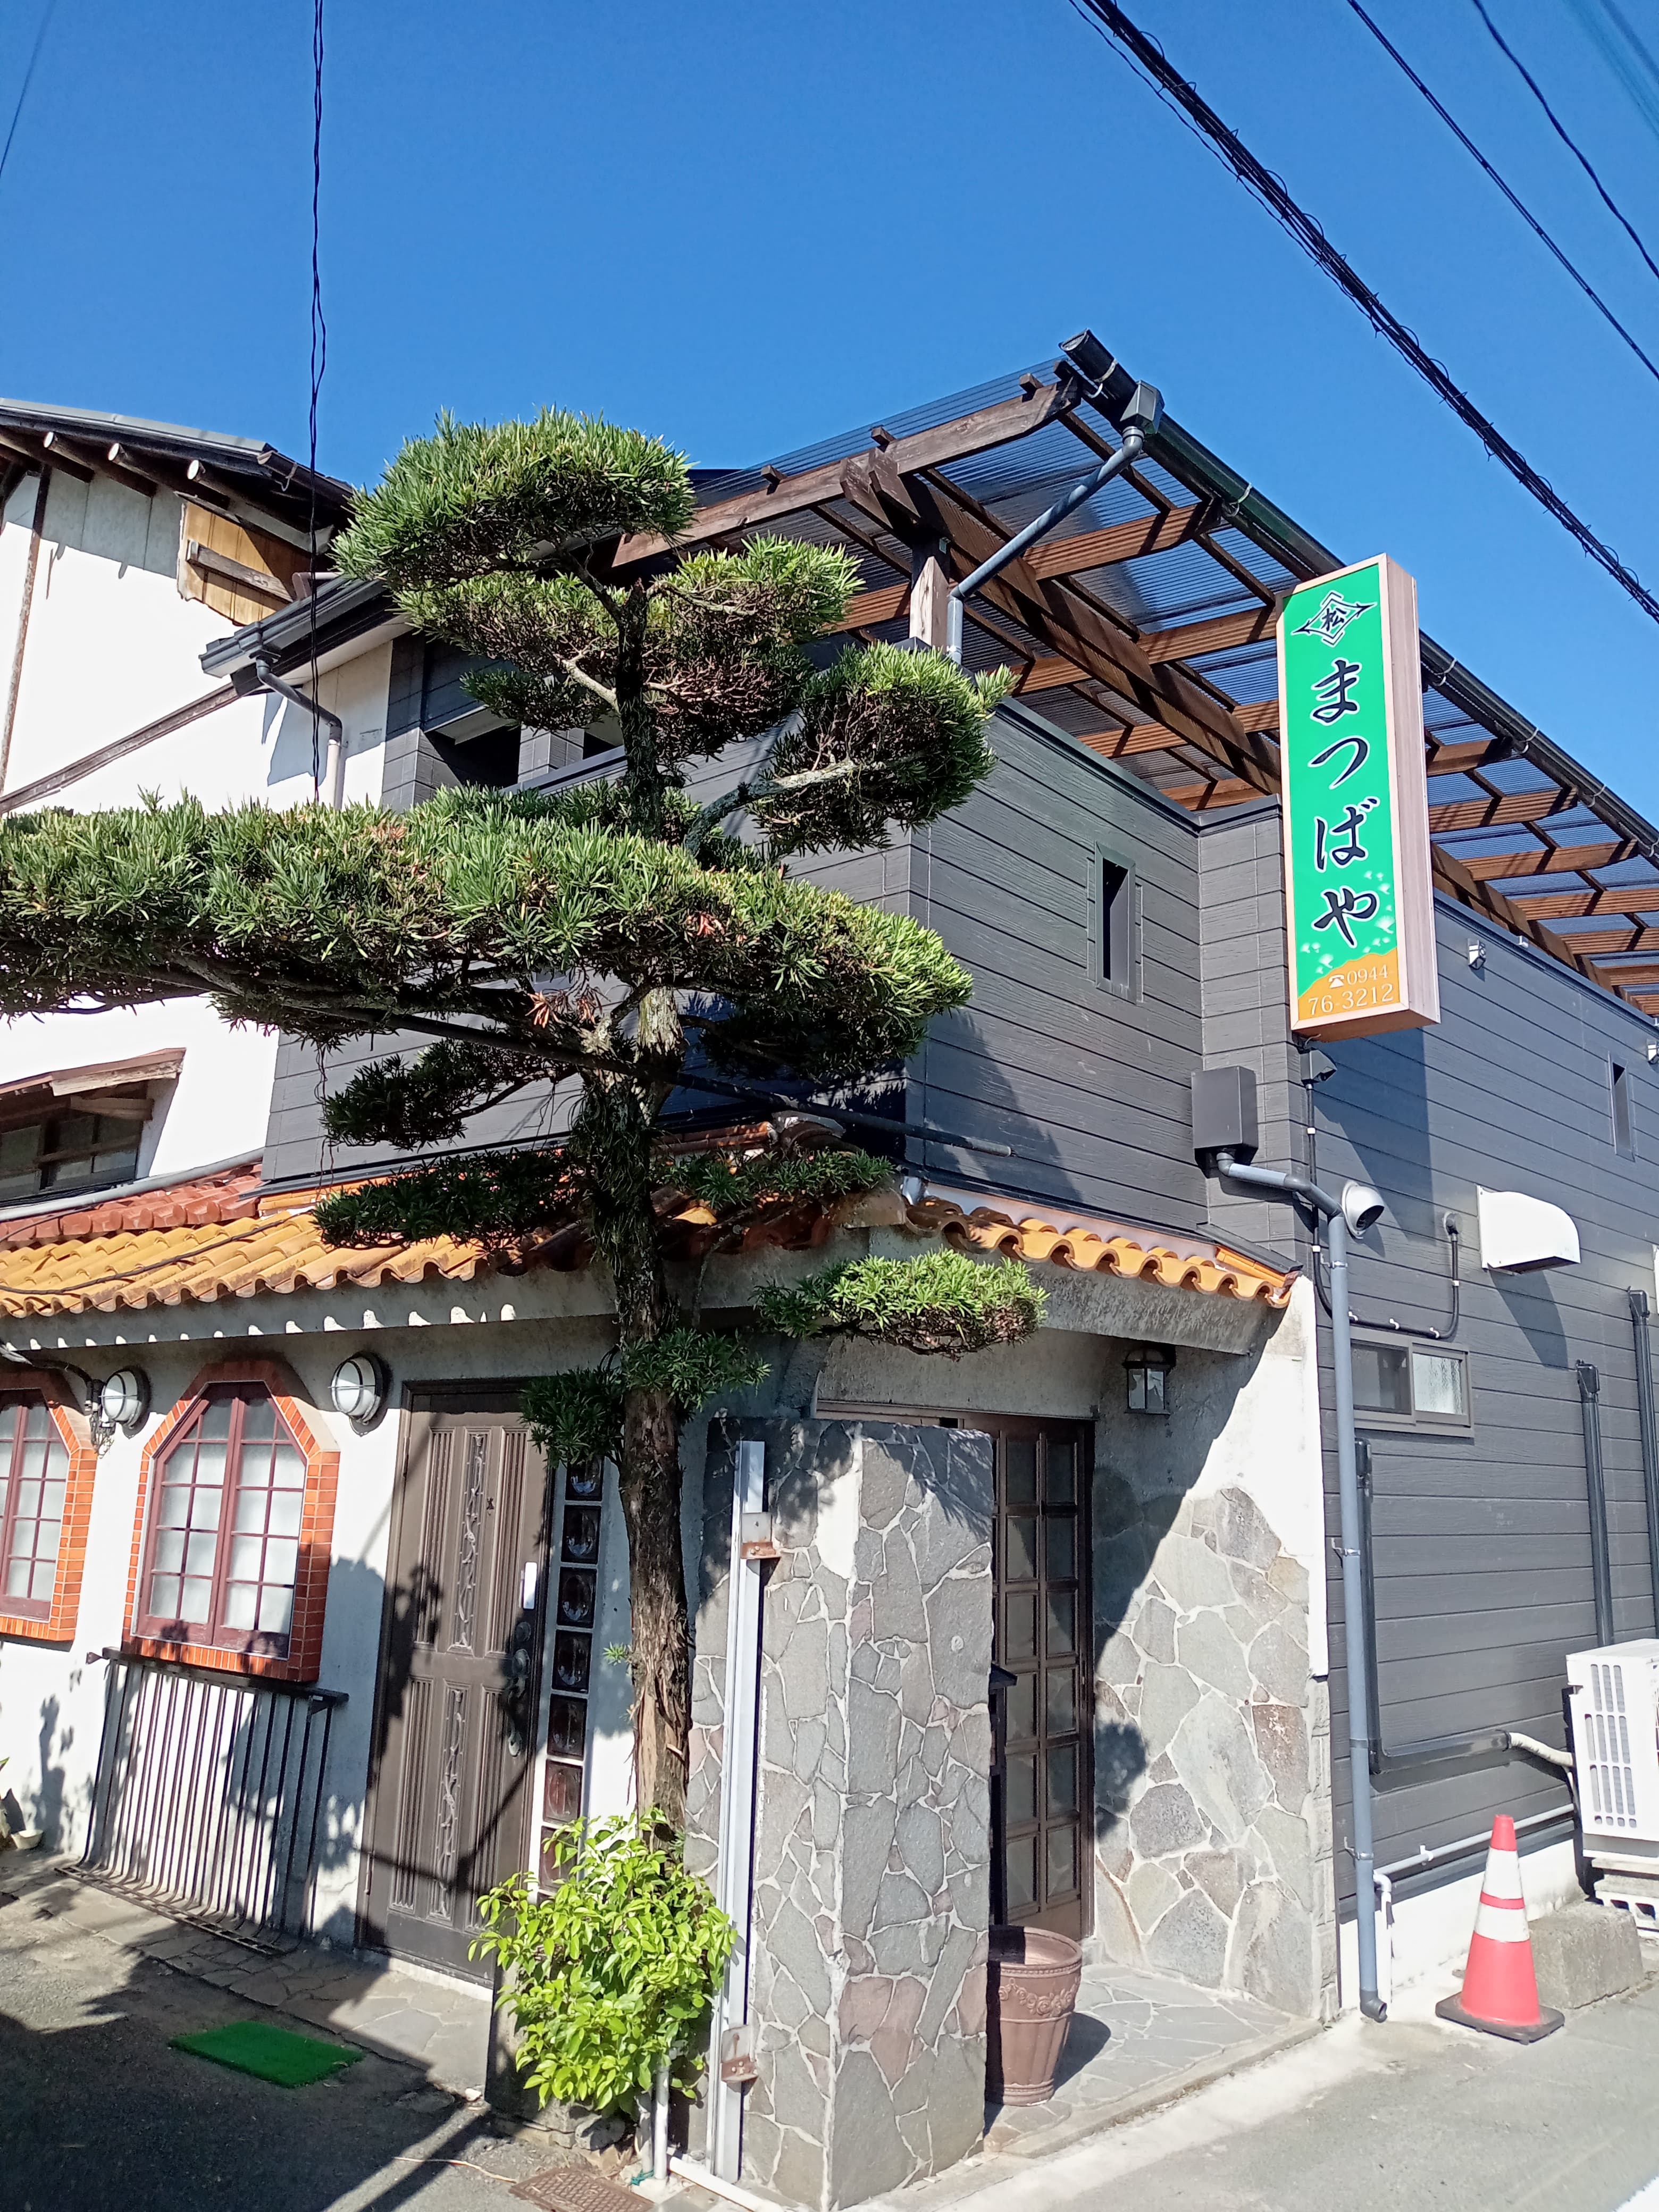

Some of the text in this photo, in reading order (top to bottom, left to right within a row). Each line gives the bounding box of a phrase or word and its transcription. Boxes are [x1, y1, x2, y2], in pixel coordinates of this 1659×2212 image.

[1321, 608, 1347, 632] 松
[1309, 658, 1378, 947] まつばや
[1308, 983, 1394, 1016] 76-3212
